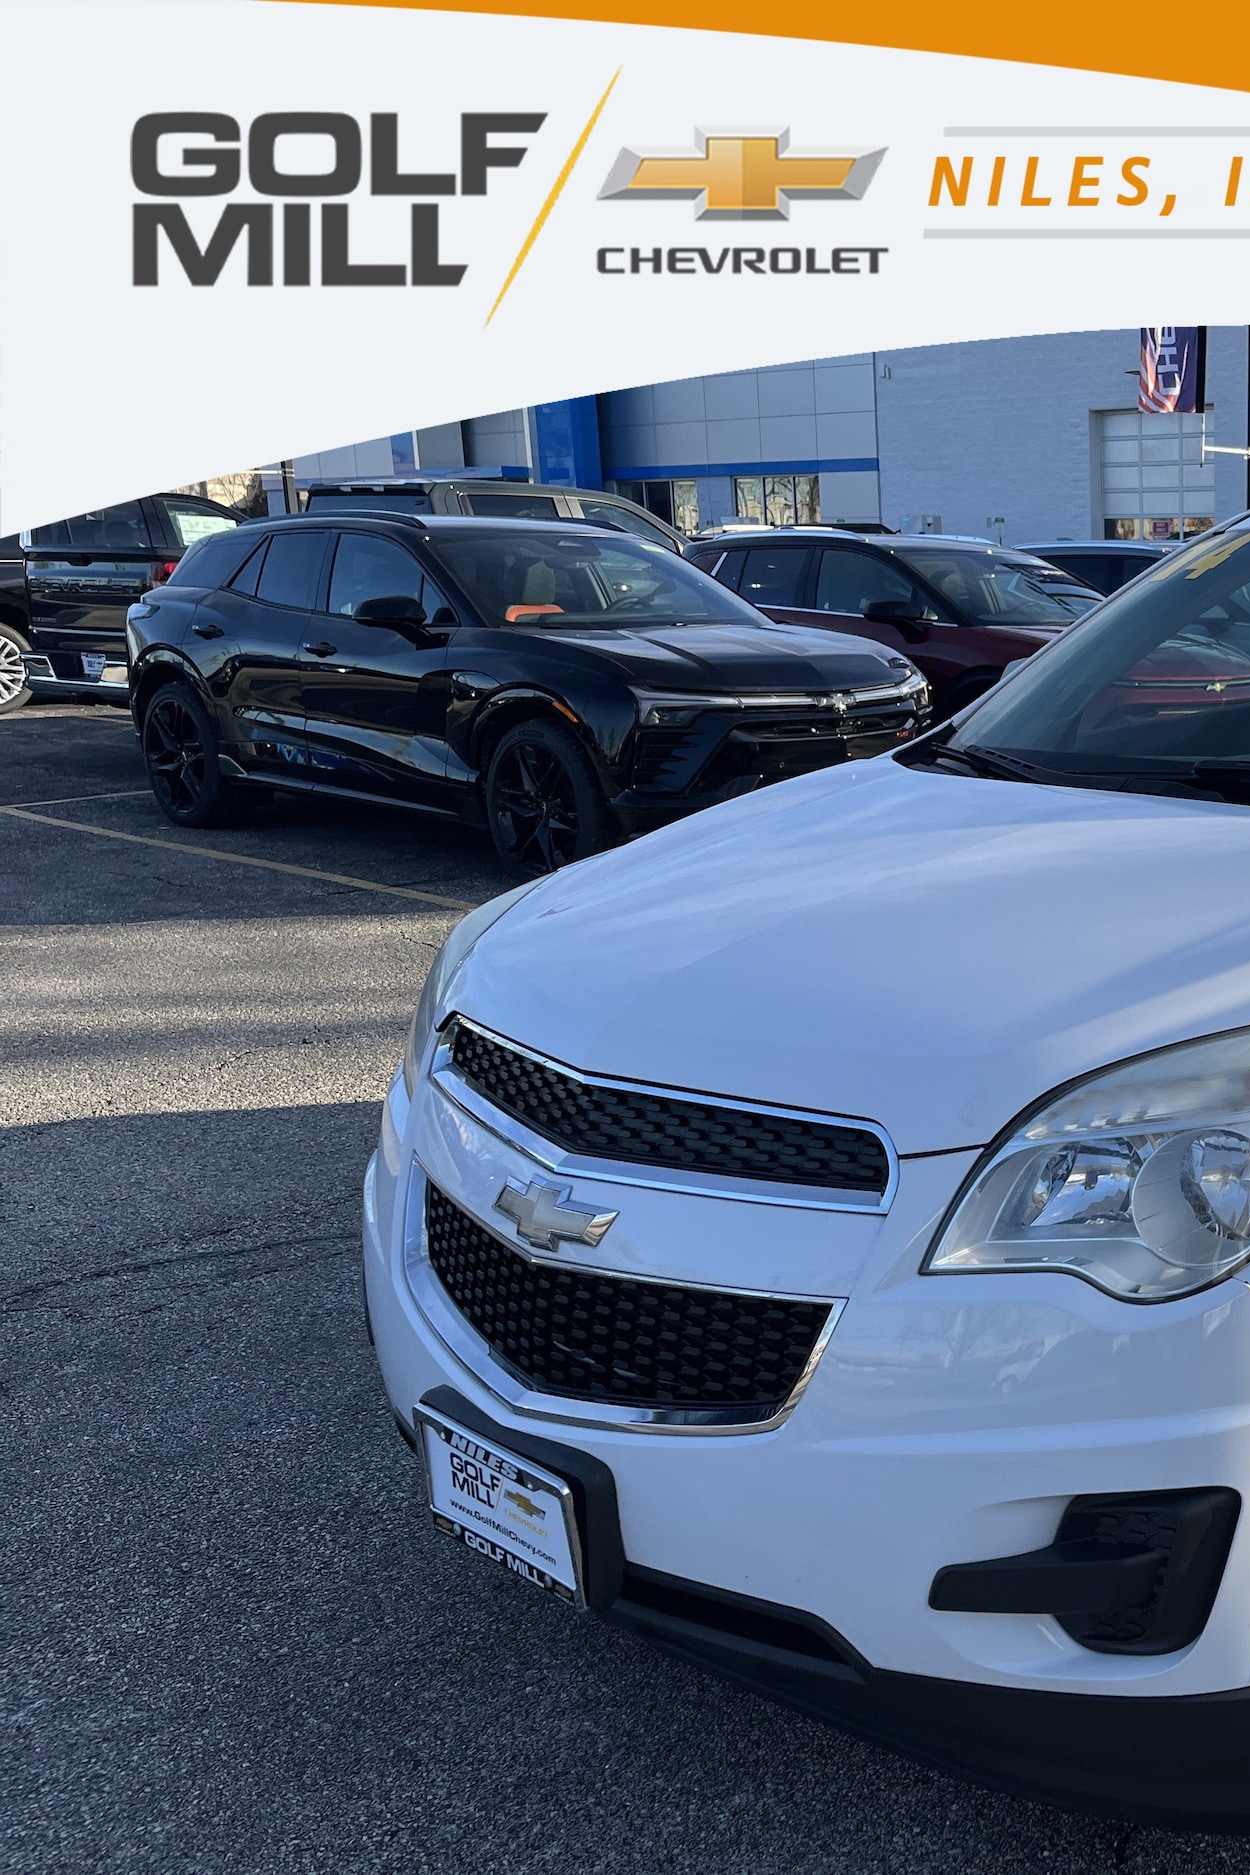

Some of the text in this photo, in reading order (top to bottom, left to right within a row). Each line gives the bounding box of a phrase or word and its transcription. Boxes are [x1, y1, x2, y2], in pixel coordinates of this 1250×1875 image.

[450, 1433, 519, 1480] NILES
[450, 1453, 501, 1490] GOLF
[452, 1471, 495, 1509] MILL
[450, 1499, 557, 1566] www.GolfMillChevy.com
[464, 1531, 545, 1588] GOLF MILL
